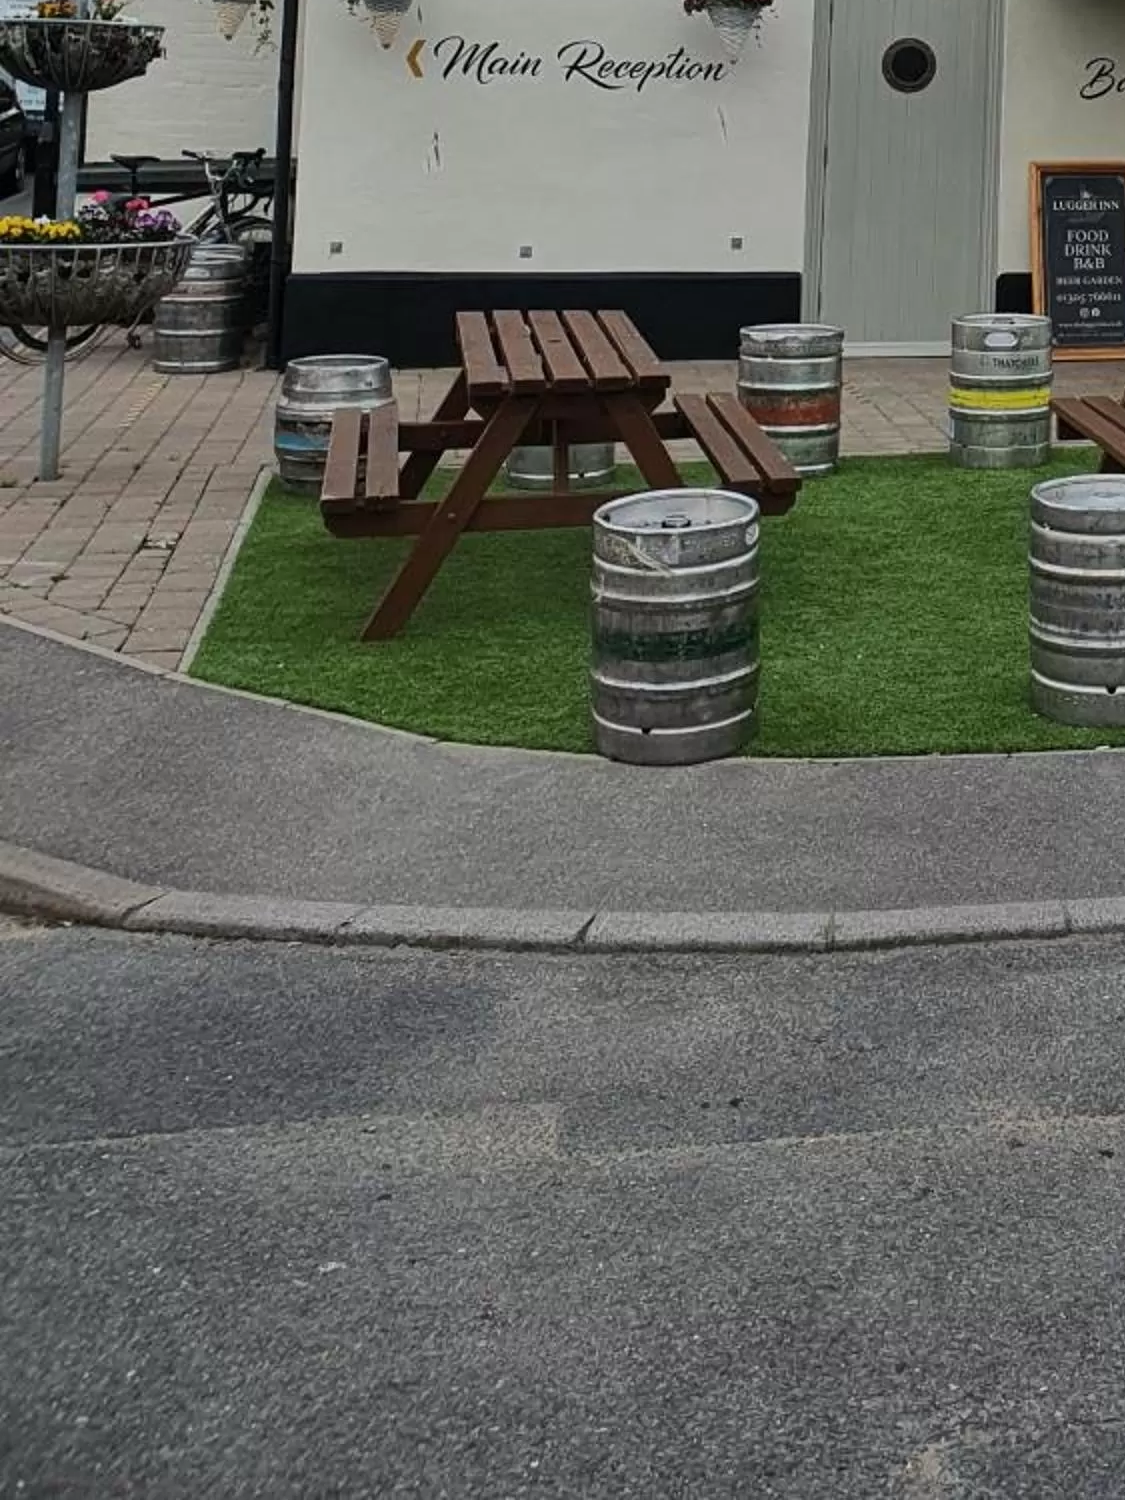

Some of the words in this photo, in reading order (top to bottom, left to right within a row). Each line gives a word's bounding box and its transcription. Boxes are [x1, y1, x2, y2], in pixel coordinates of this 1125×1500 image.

[433, 36, 543, 85] Main
[557, 40, 726, 92] Reception
[1053, 199, 1098, 211] LUGGER
[1100, 199, 1120, 211] INN
[1067, 229, 1109, 243] FOOD
[1065, 243, 1112, 257] DRINK
[1073, 257, 1105, 270] B&B
